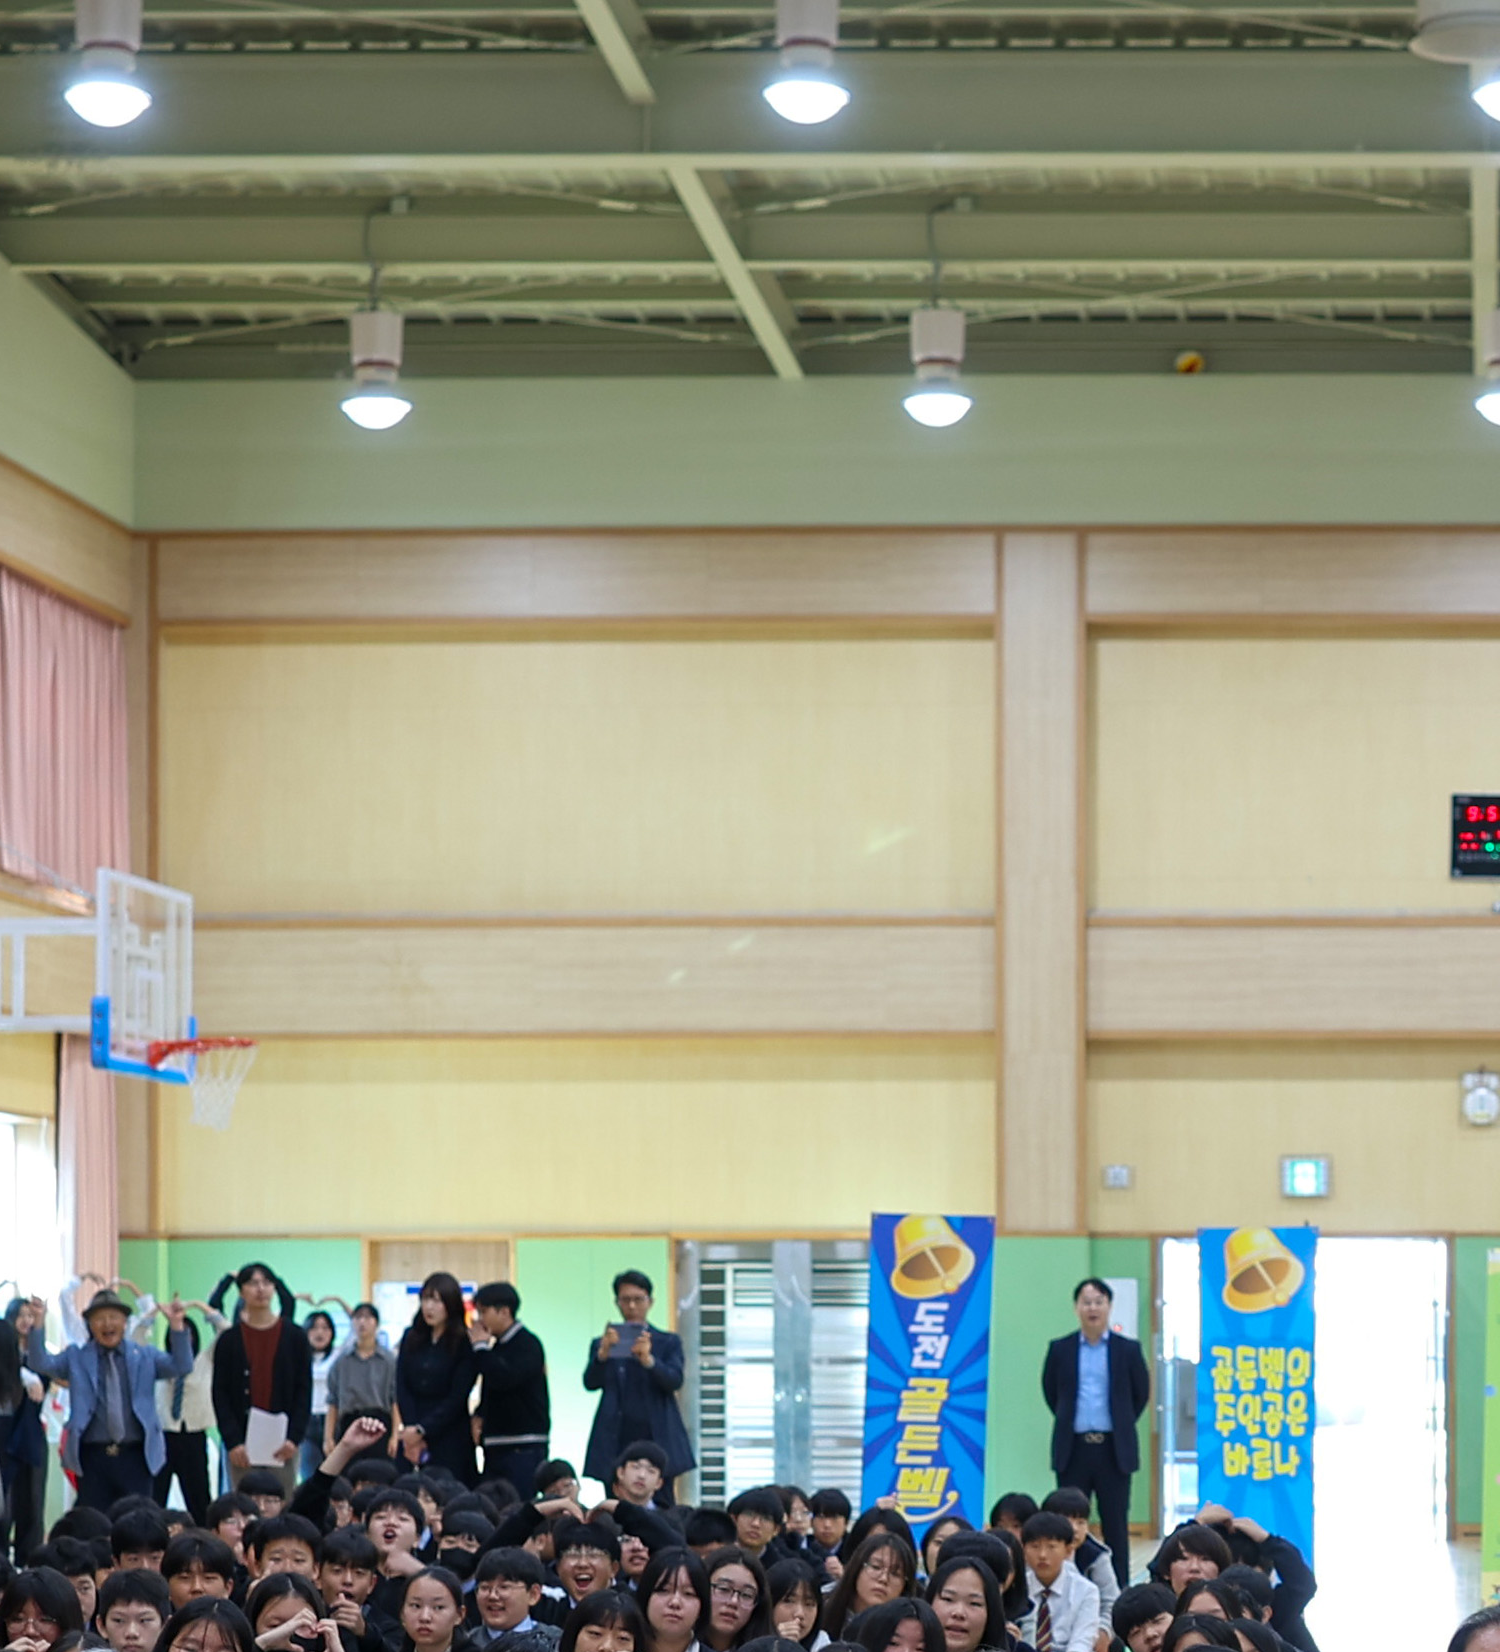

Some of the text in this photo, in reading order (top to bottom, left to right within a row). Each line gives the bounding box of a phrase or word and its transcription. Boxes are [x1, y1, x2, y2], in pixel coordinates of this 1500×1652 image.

[1211, 1345, 1311, 1391] 골든벨의
[894, 1301, 951, 1508] 도전 골든벨
[1214, 1390, 1309, 1438] 주인공은
